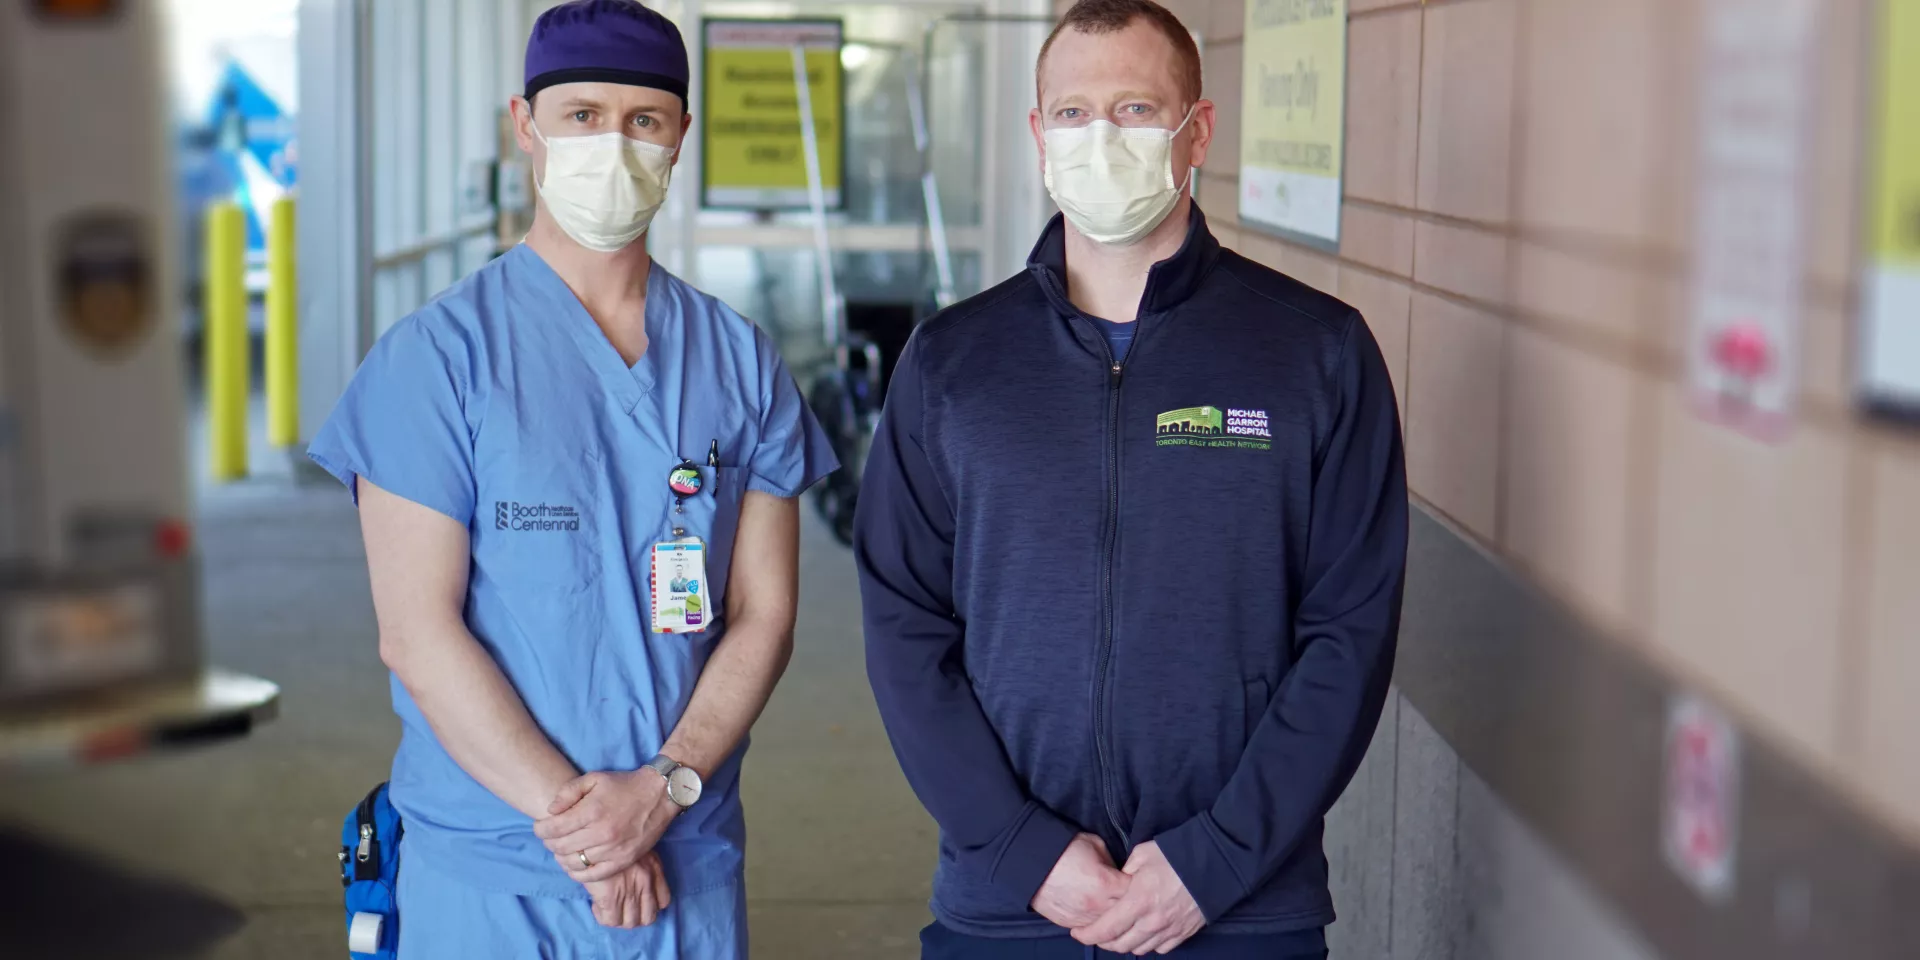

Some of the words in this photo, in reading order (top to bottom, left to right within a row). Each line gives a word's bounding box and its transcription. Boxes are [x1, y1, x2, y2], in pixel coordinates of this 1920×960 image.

[1227, 409, 1268, 419] MICHAEL
[1227, 418, 1267, 427] GARRON
[1227, 427, 1271, 436] HOSPITAL
[1156, 438, 1187, 447] TORONTO
[1189, 439, 1206, 447] EAST
[1208, 440, 1236, 448] HEALTH
[1237, 440, 1270, 450] NETWORK
[511, 501, 551, 517] Booth
[511, 517, 580, 531] Centennial
